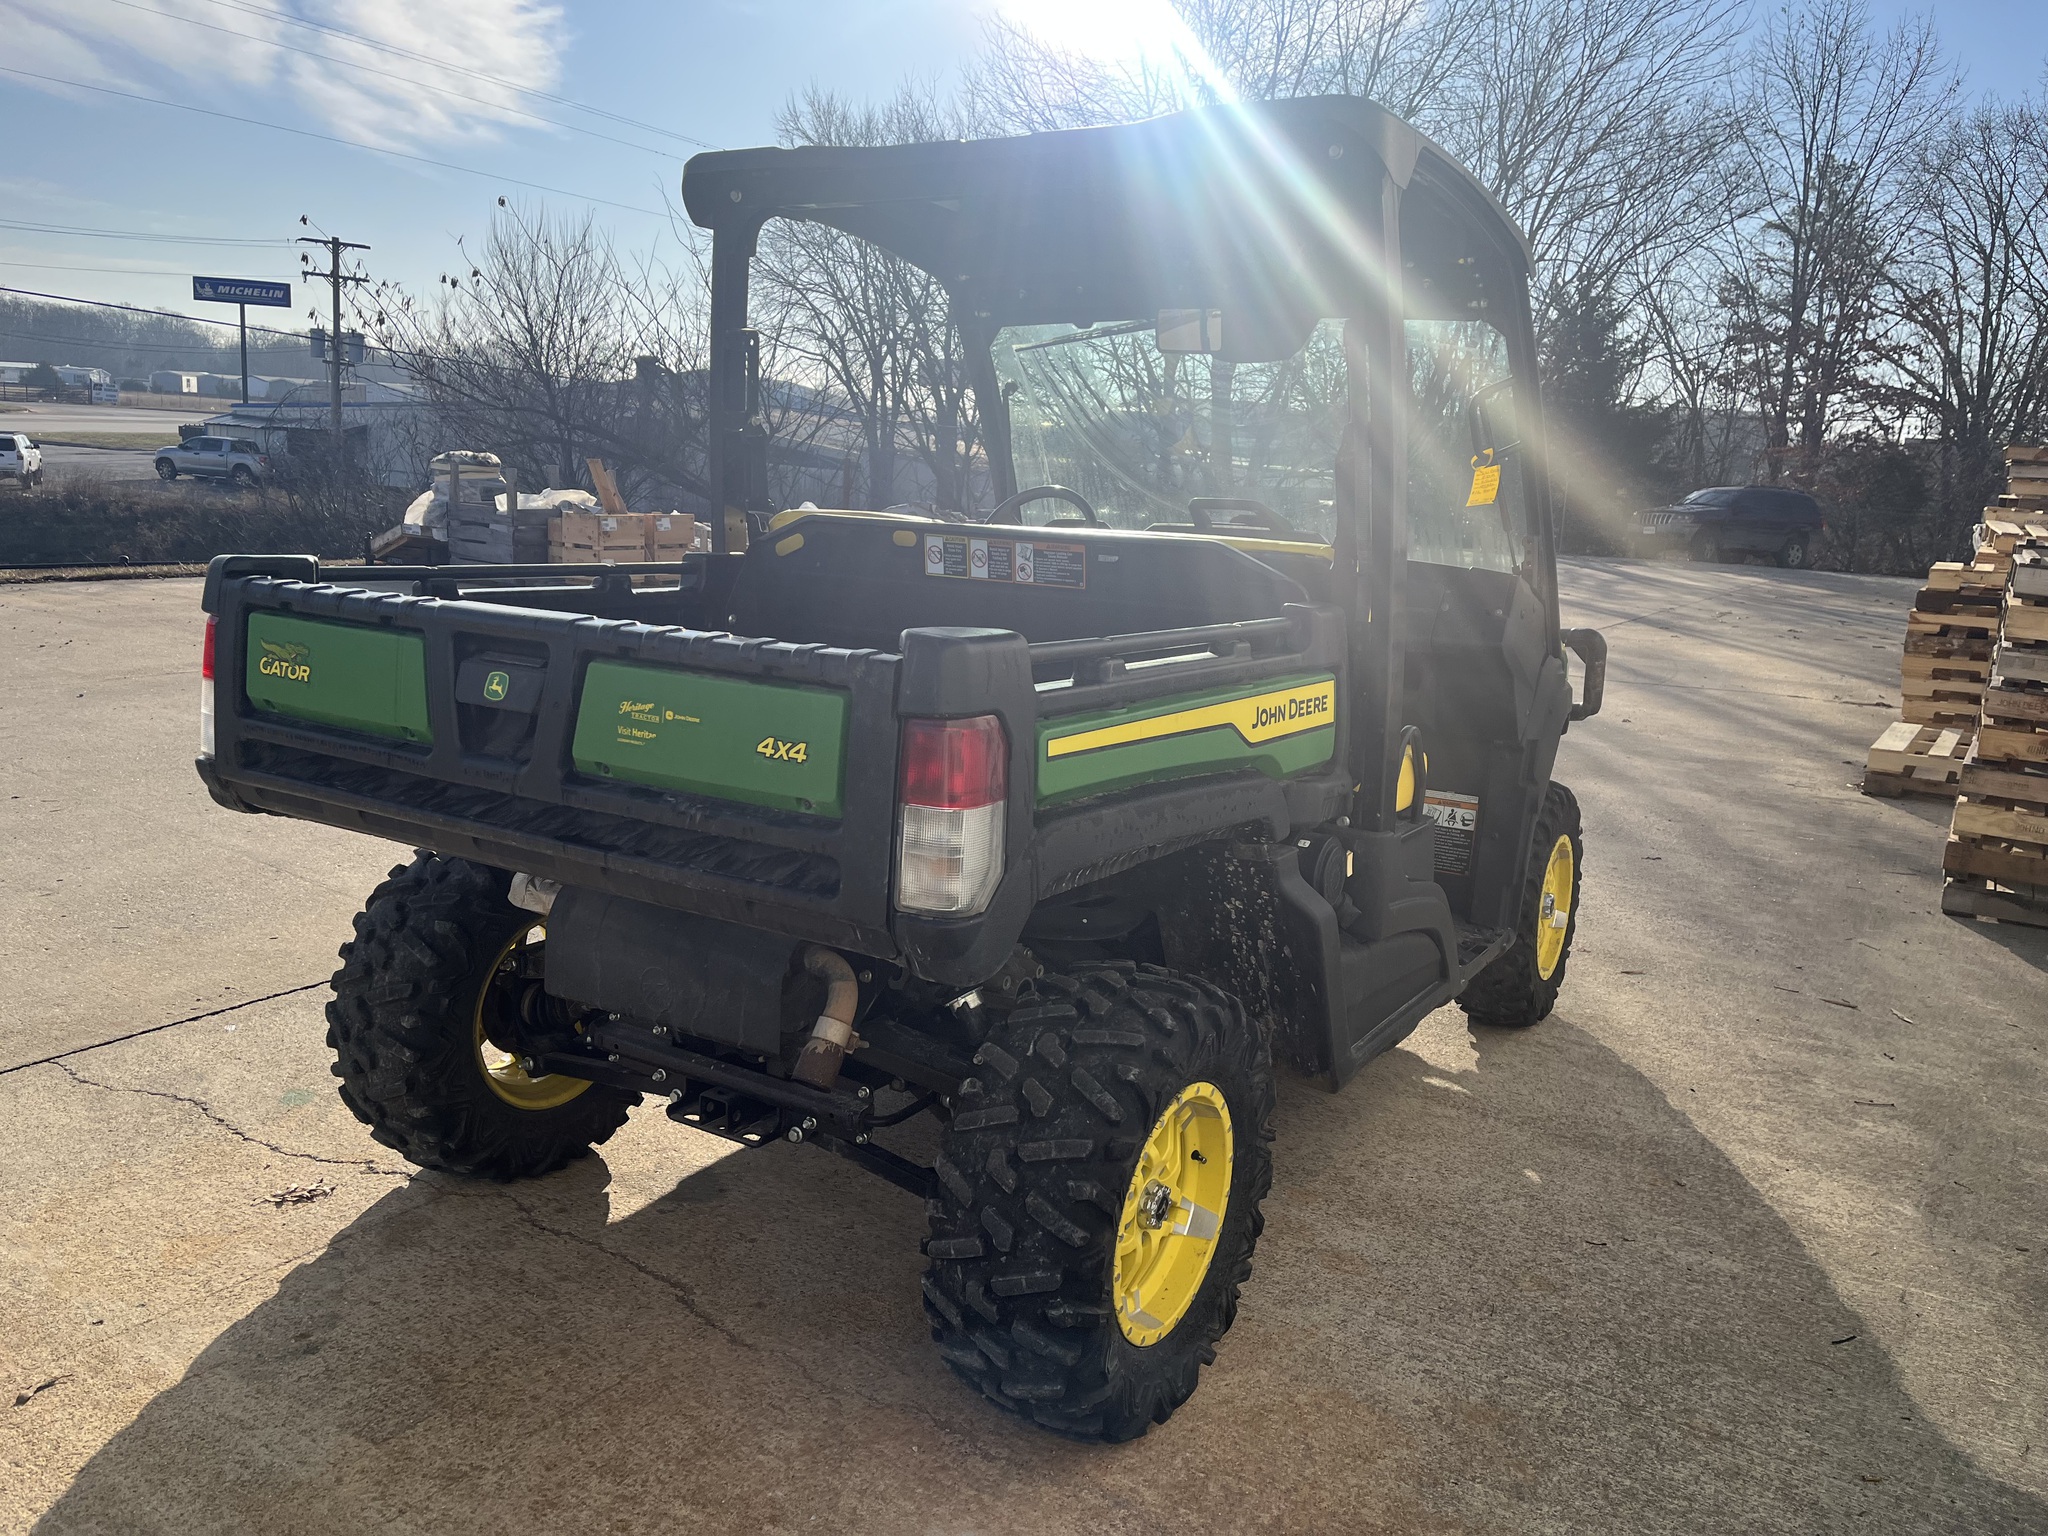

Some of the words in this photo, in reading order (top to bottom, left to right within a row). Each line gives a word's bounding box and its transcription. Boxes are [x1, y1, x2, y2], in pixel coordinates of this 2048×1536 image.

[217, 285, 284, 298] MICHELIN
[260, 656, 310, 682] GATOR
[618, 701, 655, 715] Heritage
[1251, 704, 1286, 730] JOHN
[1288, 694, 1328, 720] DEERE
[631, 712, 660, 723] TRACTOR
[617, 725, 631, 736] Visit
